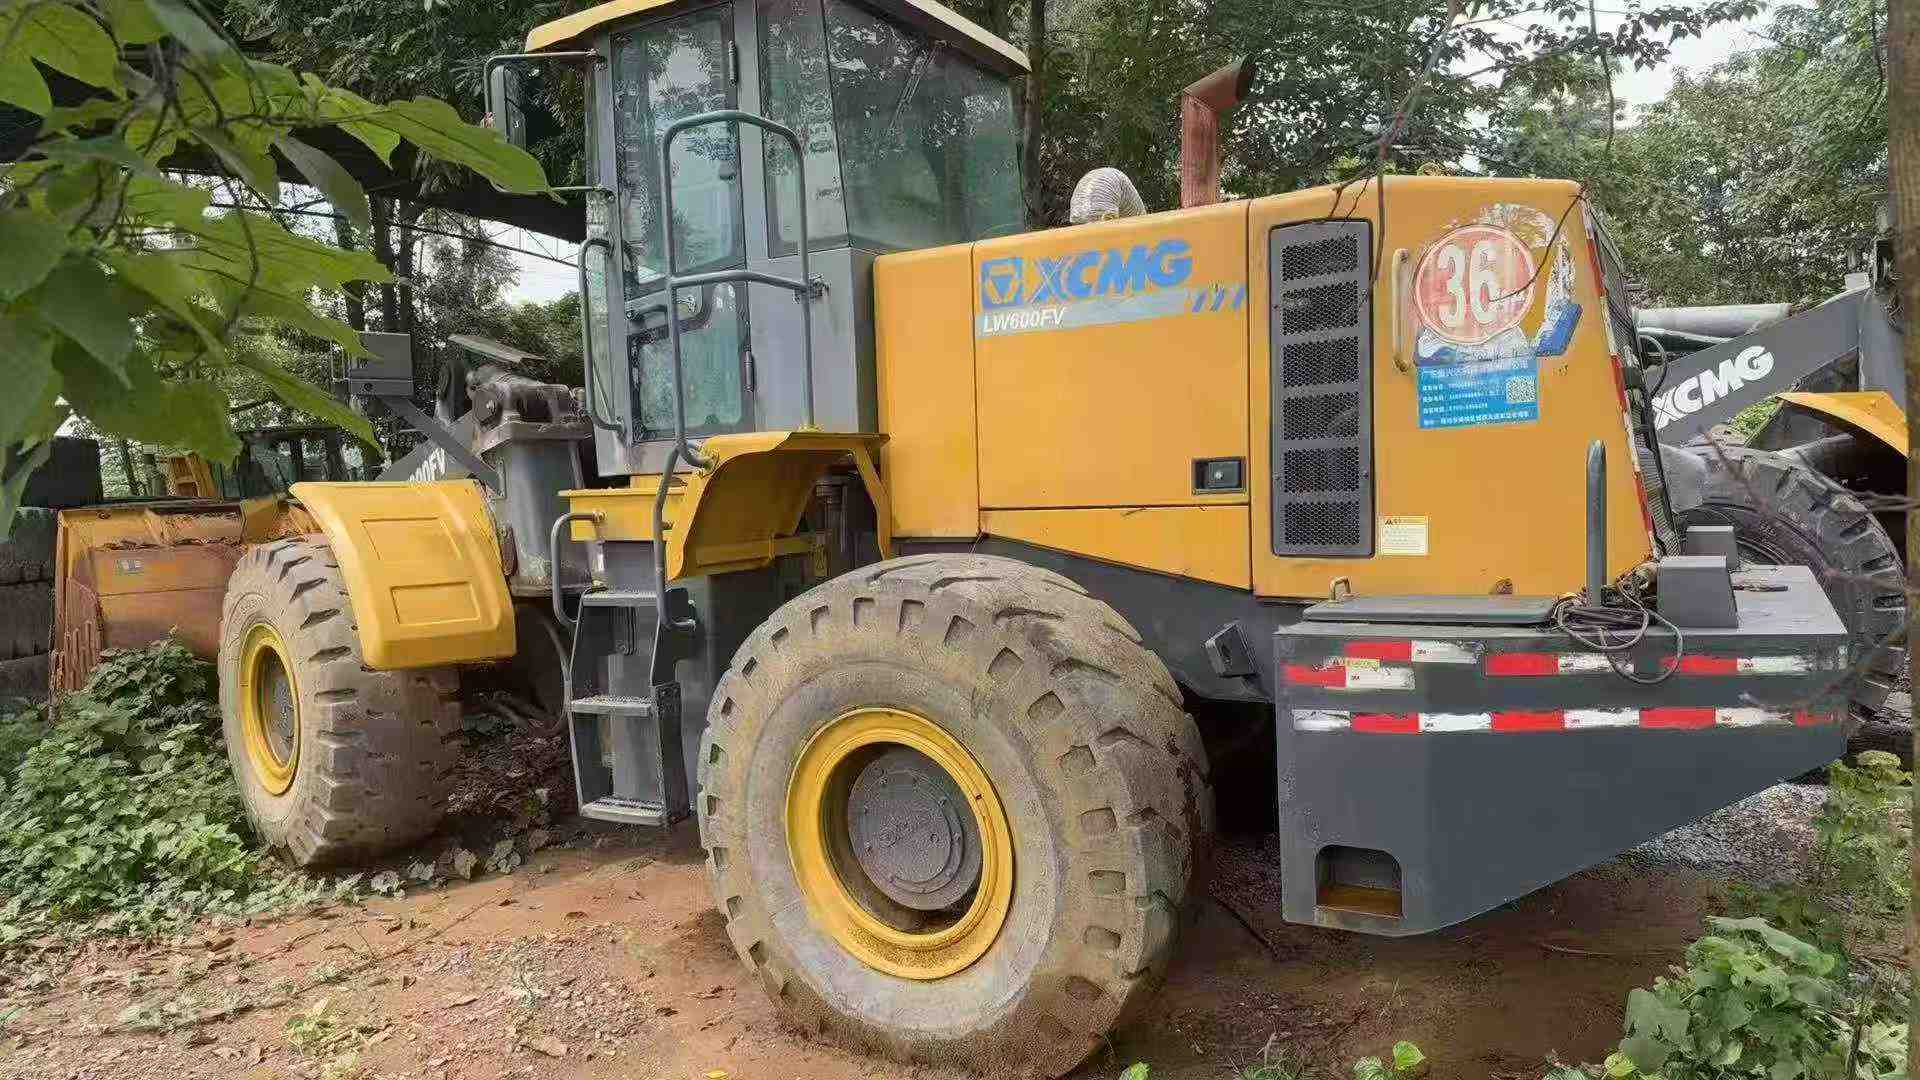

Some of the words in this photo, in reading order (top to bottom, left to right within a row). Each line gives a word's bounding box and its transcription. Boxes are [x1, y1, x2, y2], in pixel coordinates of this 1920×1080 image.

[1030, 238, 1193, 304] XCMG
[983, 306, 1068, 333] LW600FV
[1651, 345, 1775, 430] XCMG
